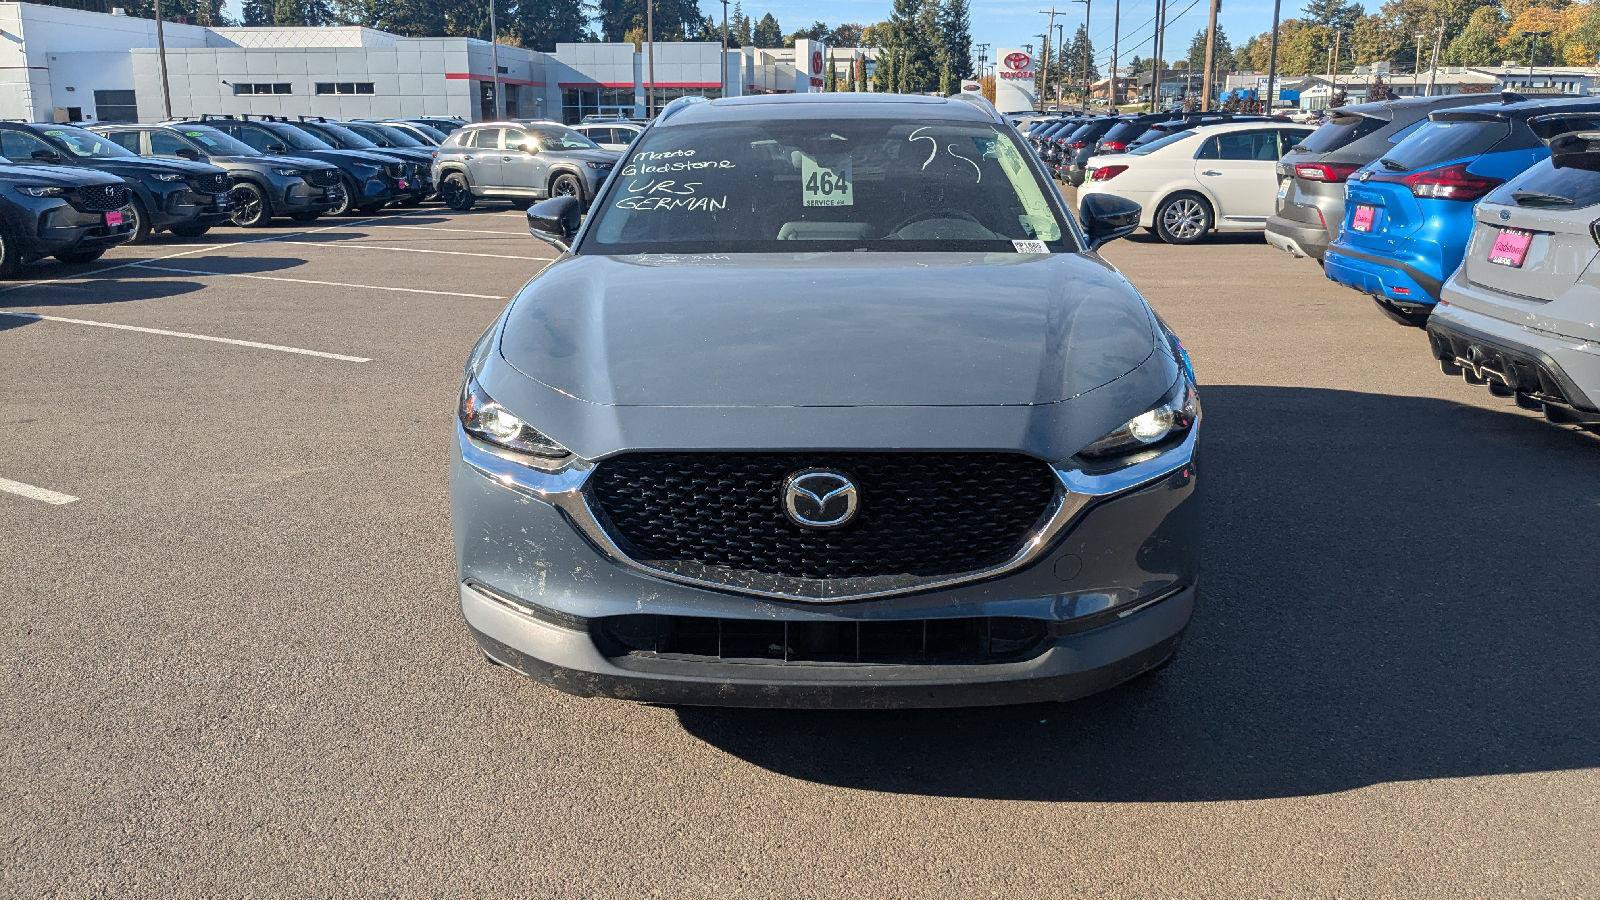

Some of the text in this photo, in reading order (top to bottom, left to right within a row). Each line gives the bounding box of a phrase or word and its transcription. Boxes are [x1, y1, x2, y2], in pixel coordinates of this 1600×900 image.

[621, 160, 736, 176] Gladstone
[806, 171, 848, 196] 464
[615, 195, 727, 212] GERMAN
